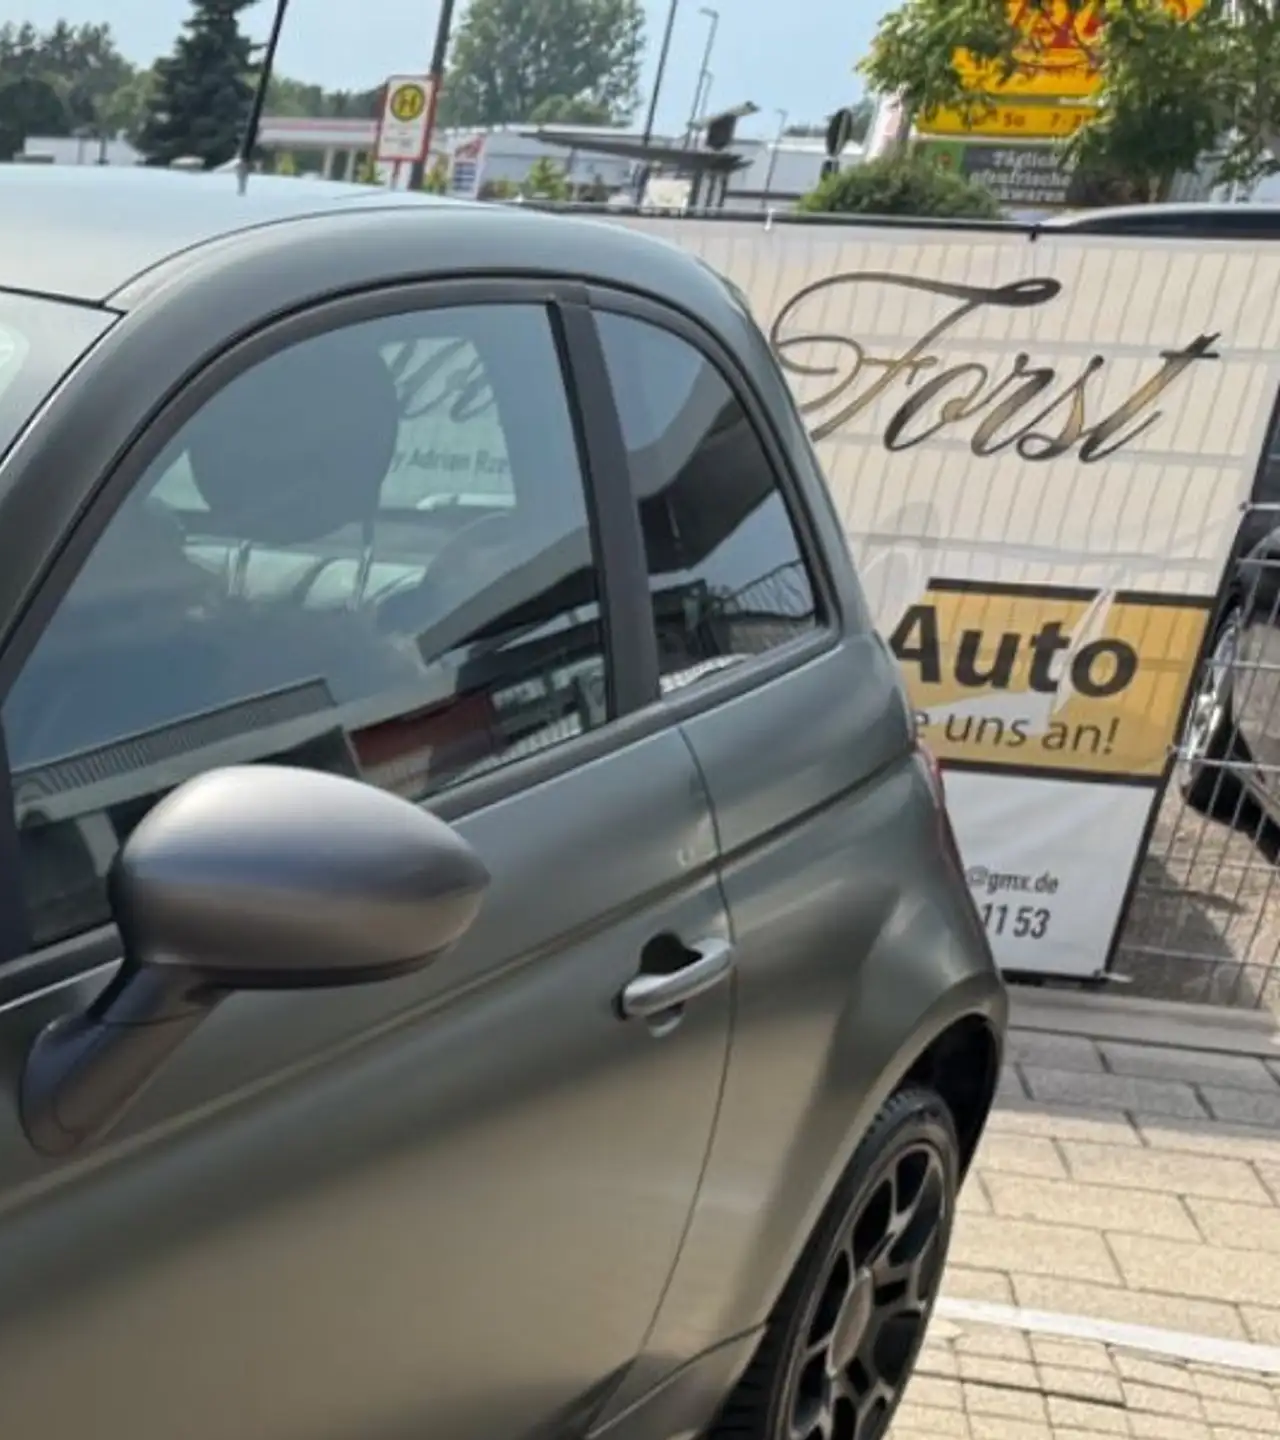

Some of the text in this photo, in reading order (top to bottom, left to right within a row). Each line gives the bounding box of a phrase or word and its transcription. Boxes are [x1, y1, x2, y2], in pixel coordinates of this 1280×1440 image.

[771, 271, 1222, 463] Forst
[888, 604, 1138, 698] Auto
[945, 713, 1032, 748] uns
[1042, 717, 1121, 756] an!
[966, 864, 1060, 896] @gmx.de
